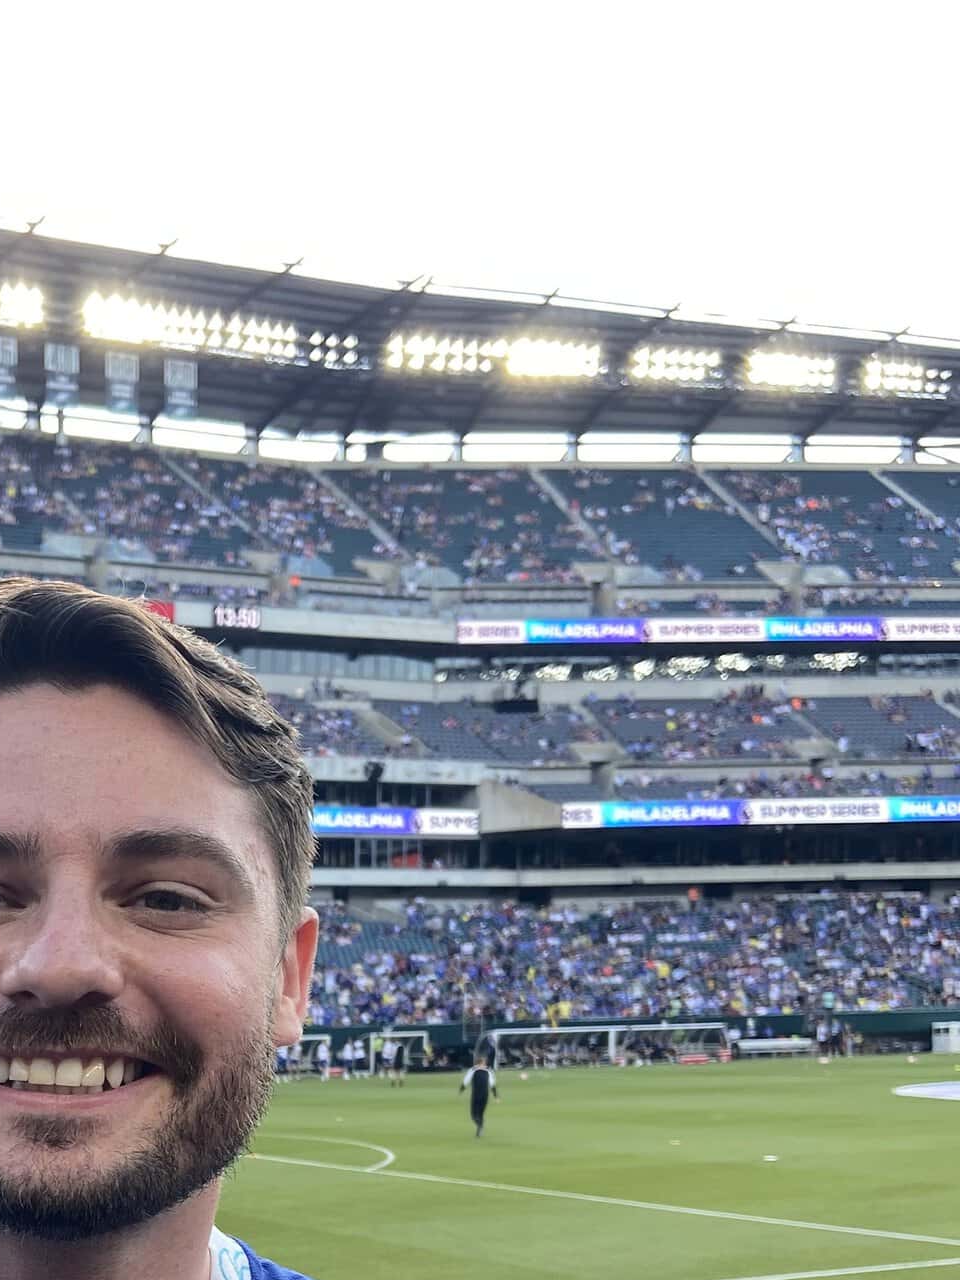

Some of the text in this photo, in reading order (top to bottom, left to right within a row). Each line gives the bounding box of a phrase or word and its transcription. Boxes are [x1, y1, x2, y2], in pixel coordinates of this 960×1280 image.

[531, 623, 636, 639] PHILADELPHIA
[771, 621, 873, 637] PHILADELPHIA
[613, 804, 731, 822] PHILADELPHIA
[759, 802, 881, 819] SUMMER SERIES
